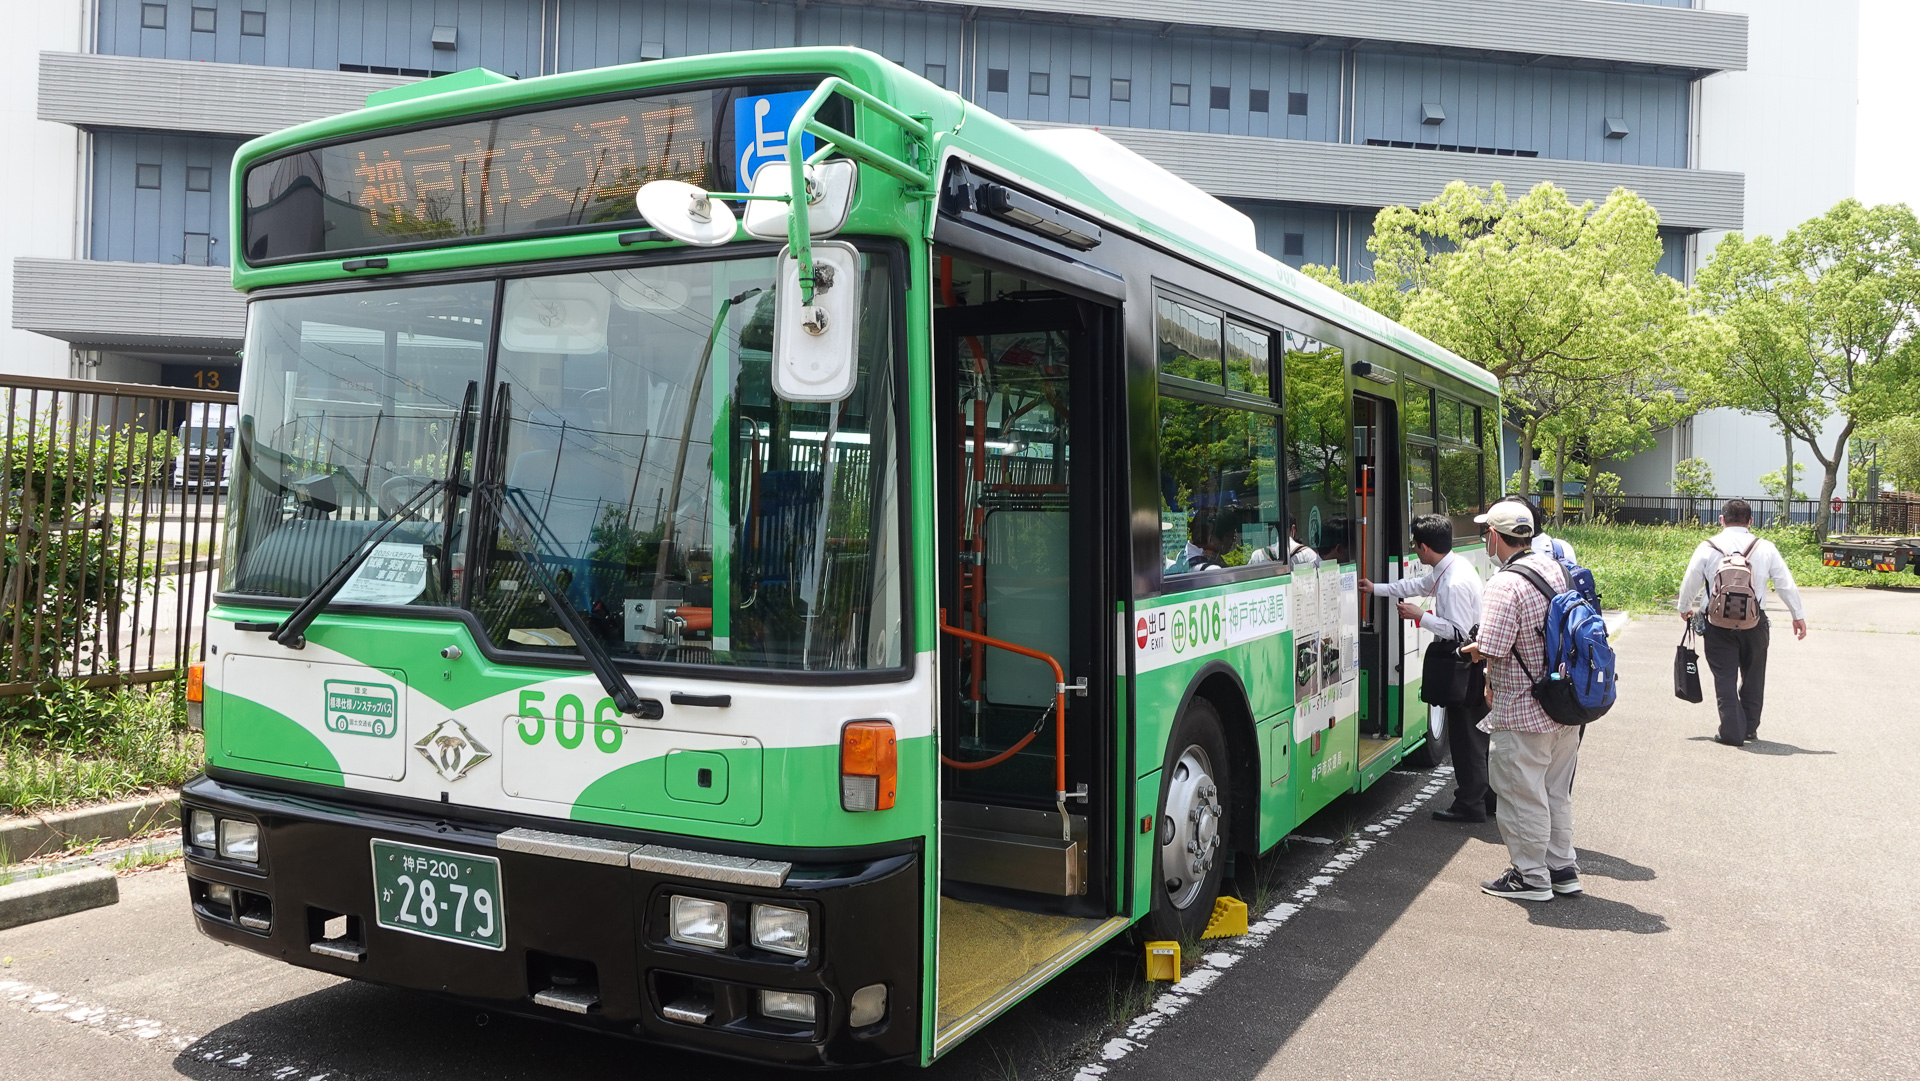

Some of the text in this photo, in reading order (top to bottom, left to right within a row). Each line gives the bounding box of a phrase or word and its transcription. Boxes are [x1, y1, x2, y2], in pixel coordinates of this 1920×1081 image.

[354, 105, 705, 226] 神戸市交通局
[194, 371, 220, 389] 13
[1149, 612, 1166, 635] 出口
[1228, 594, 1284, 634] 神戸市交通局
[1151, 636, 1164, 650] EXIT
[330, 696, 392, 714] 標準仕様ノンステップバス
[517, 689, 624, 754] 506
[402, 854, 459, 880] 神戸200
[382, 887, 394, 903] か
[397, 874, 494, 938] 28-79
